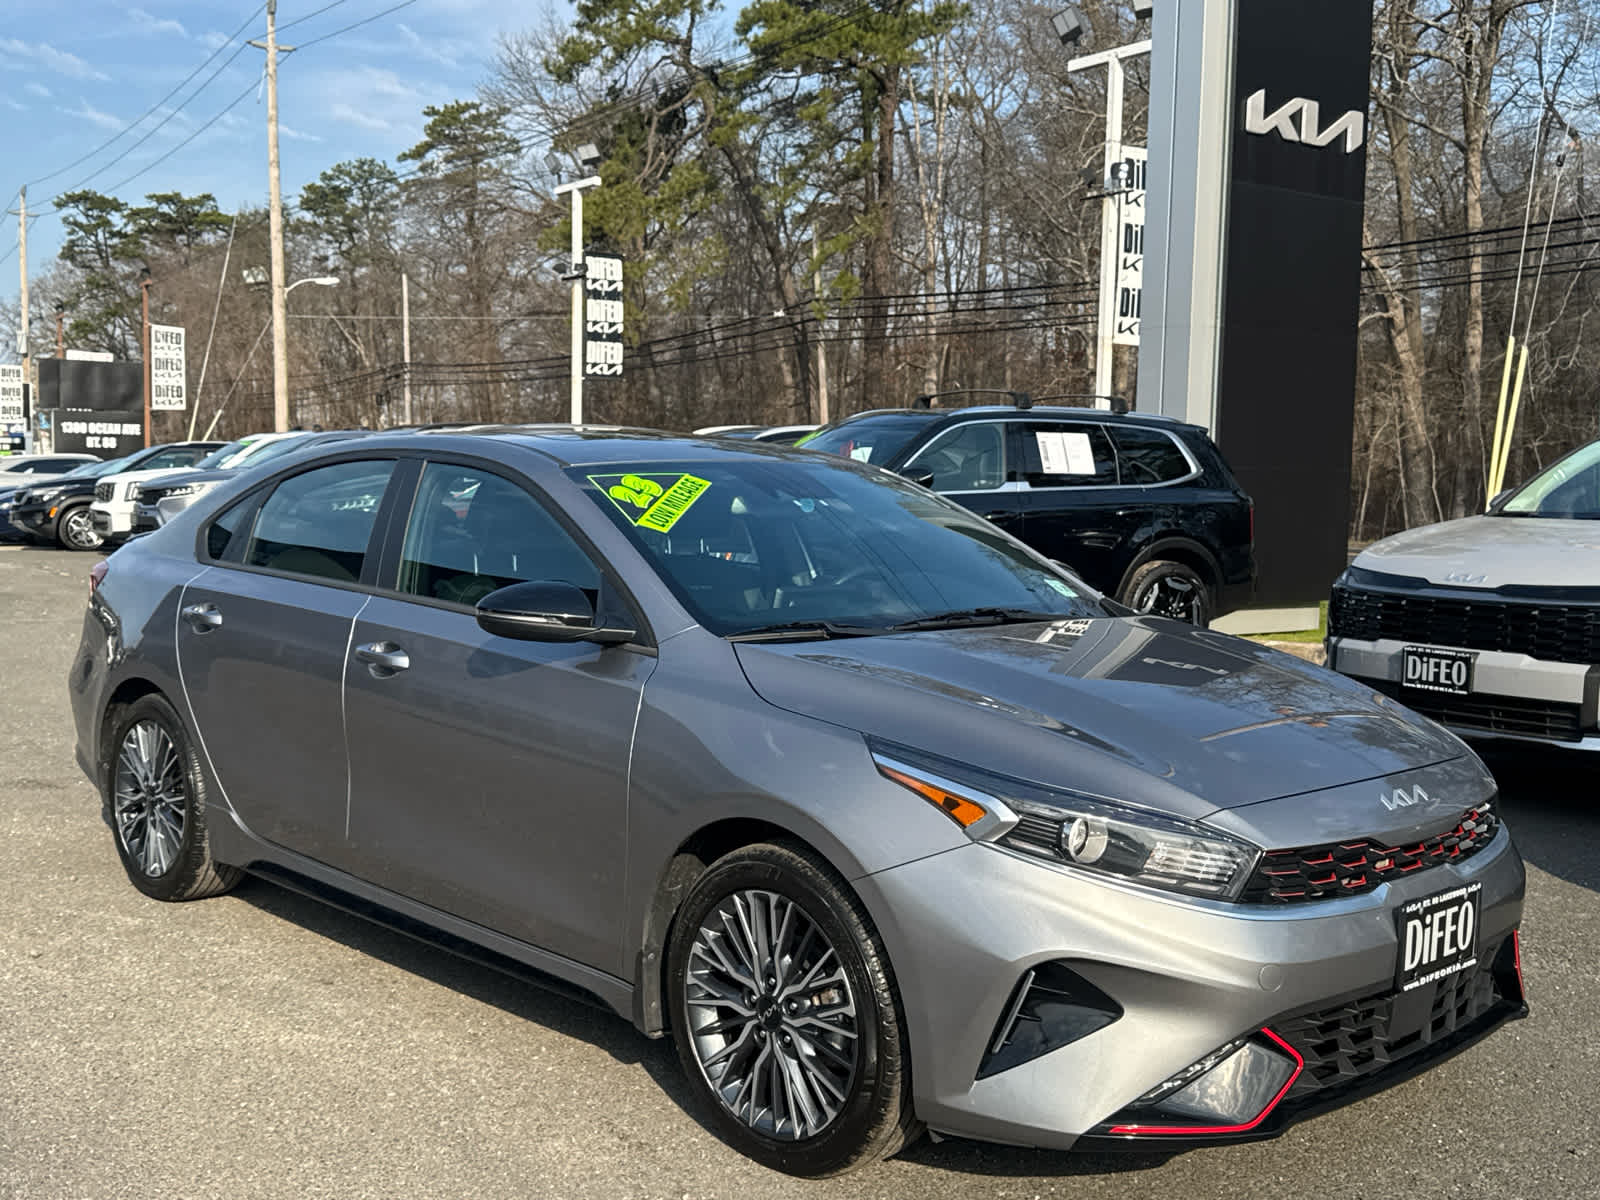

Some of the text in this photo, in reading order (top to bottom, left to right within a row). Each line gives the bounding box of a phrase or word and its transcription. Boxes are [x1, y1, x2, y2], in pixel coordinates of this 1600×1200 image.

[1246, 88, 1364, 153] KIA
[645, 478, 703, 528] LOW MILEAGE
[1407, 655, 1467, 687] DiFEO
[1404, 901, 1474, 972] DiFEO
